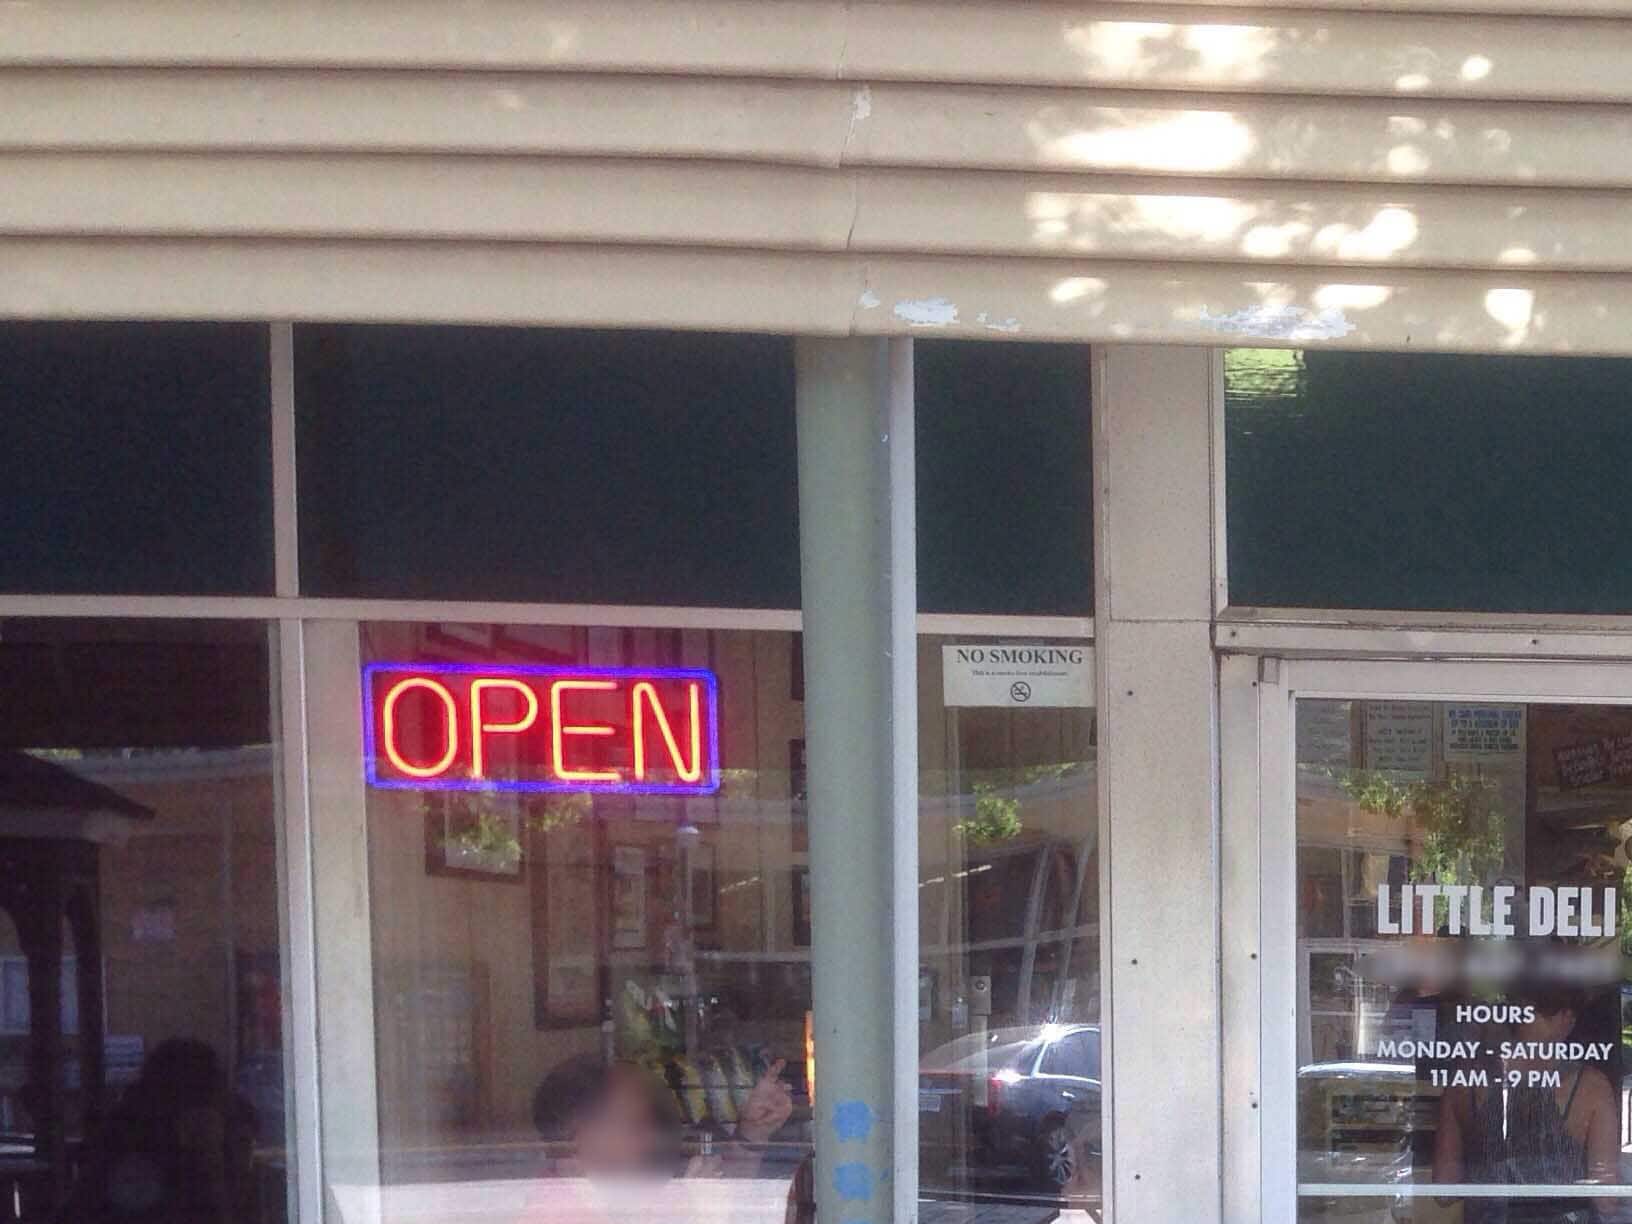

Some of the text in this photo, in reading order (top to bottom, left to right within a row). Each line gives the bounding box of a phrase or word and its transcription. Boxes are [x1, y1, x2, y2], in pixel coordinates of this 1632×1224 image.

[957, 649, 1083, 665] NO SMOKING
[382, 676, 702, 783] OPEN
[1377, 883, 1617, 937] LITTLE DELI
[1456, 1005, 1536, 1024] HOURS
[1376, 1041, 1481, 1059] MONDAY
[1500, 1041, 1614, 1061] SATURDAY
[1508, 1070, 1522, 1088] 9
[1528, 1070, 1561, 1088] PM
